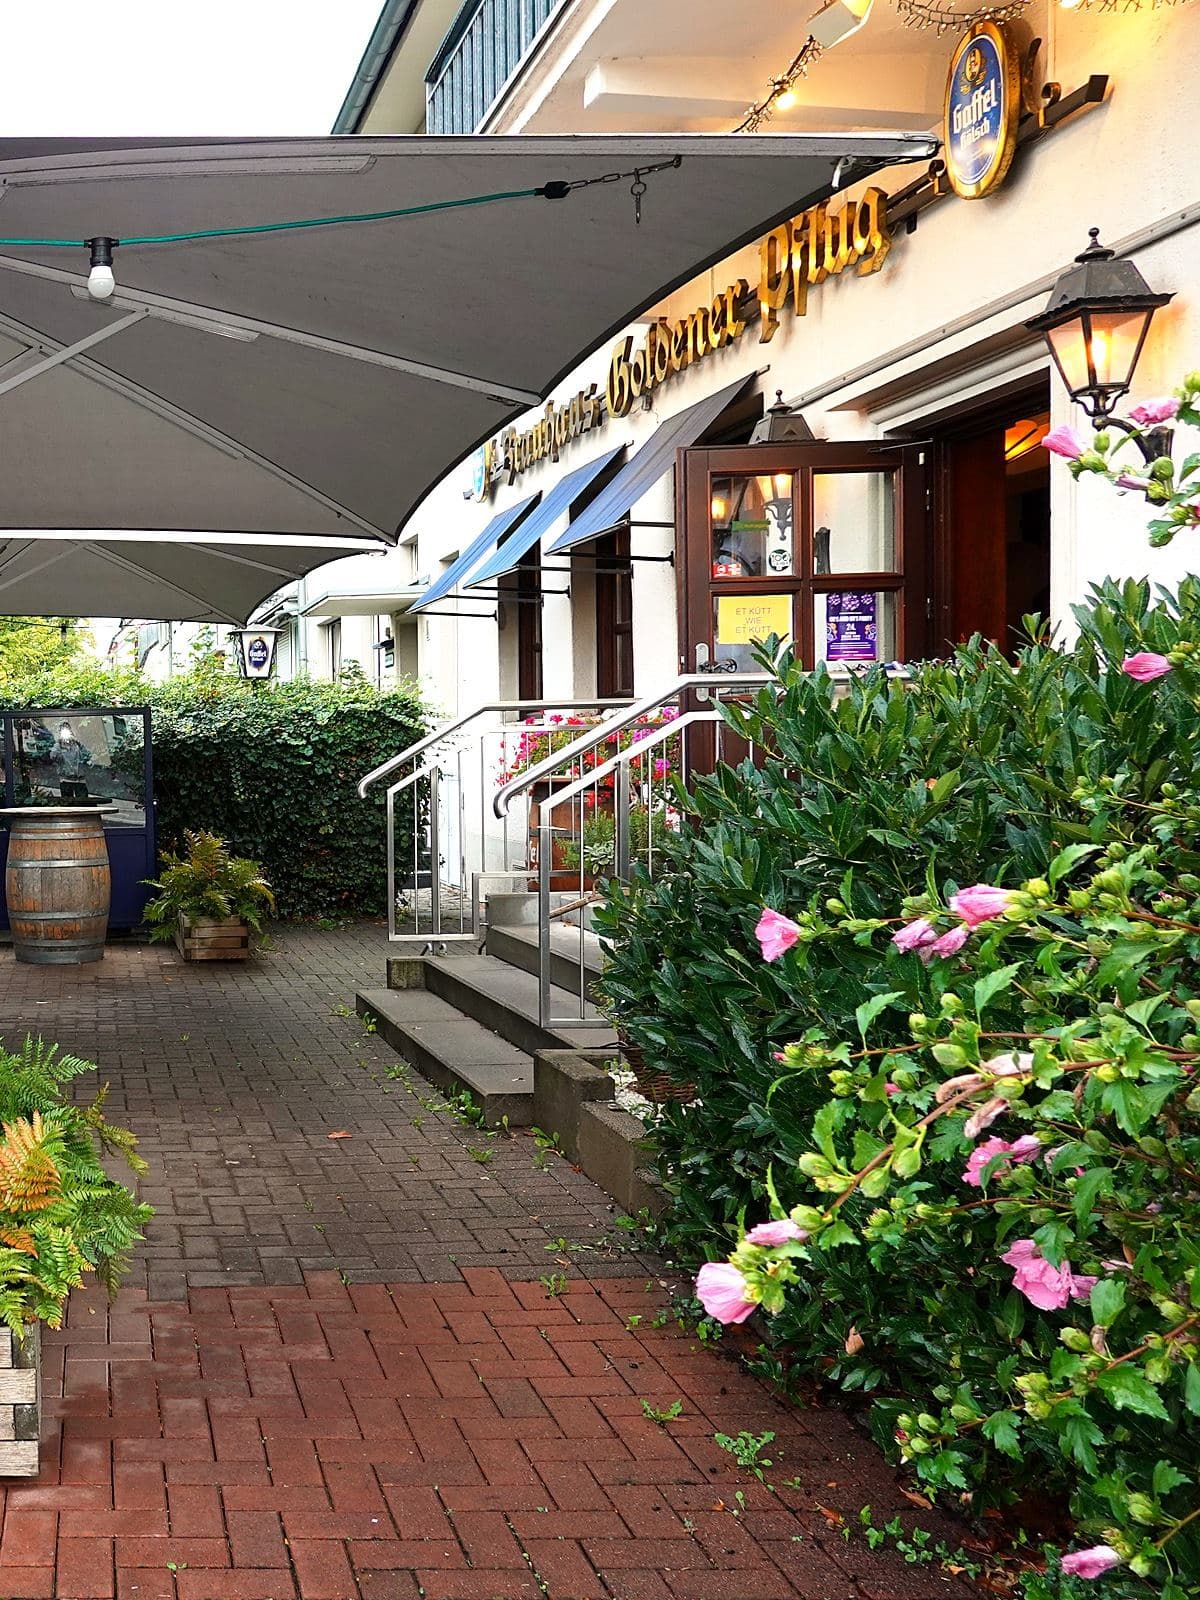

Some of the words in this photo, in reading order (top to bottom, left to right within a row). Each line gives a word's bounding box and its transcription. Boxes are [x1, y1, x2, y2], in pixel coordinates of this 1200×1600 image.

[953, 78, 998, 134] Gaffel
[606, 279, 750, 418] Goldener
[757, 187, 891, 343] Pflug
